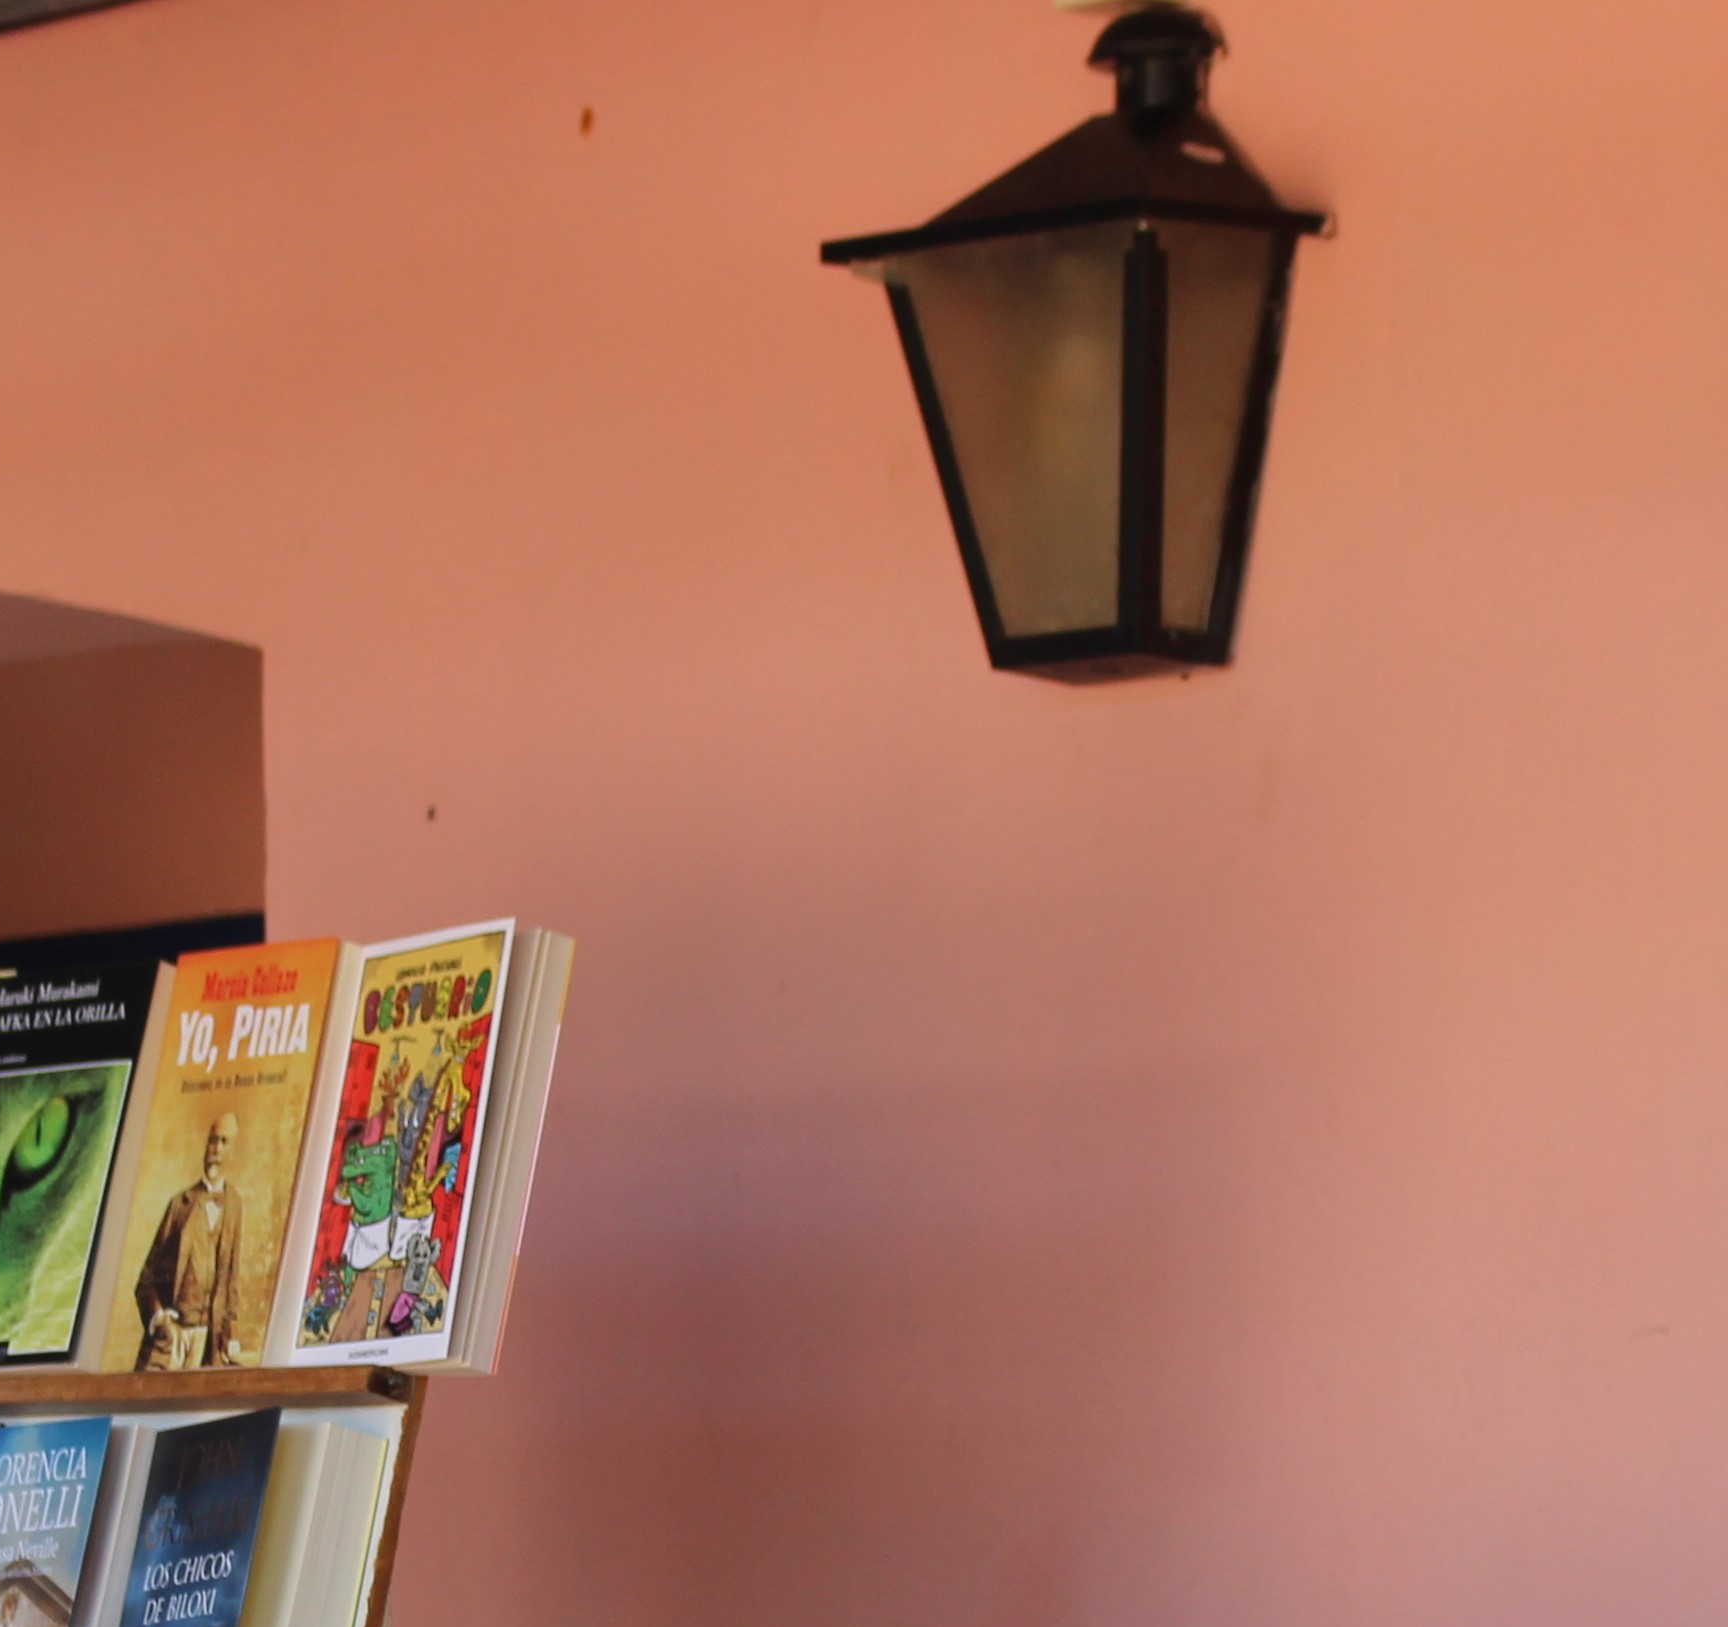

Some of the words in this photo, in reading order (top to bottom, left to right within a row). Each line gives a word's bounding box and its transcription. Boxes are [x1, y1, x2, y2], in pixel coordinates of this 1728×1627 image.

[37, 979, 101, 1006] Murakami
[33, 1009, 53, 1028] EN
[54, 1007, 72, 1026] LA
[74, 1002, 126, 1023] ORILLA
[227, 1002, 311, 1061] PIRIA
[143, 1561, 170, 1593] LOS
[173, 1549, 235, 1587] CHICOS
[143, 1597, 165, 1627] DE
[167, 1588, 217, 1621] BILOXI
